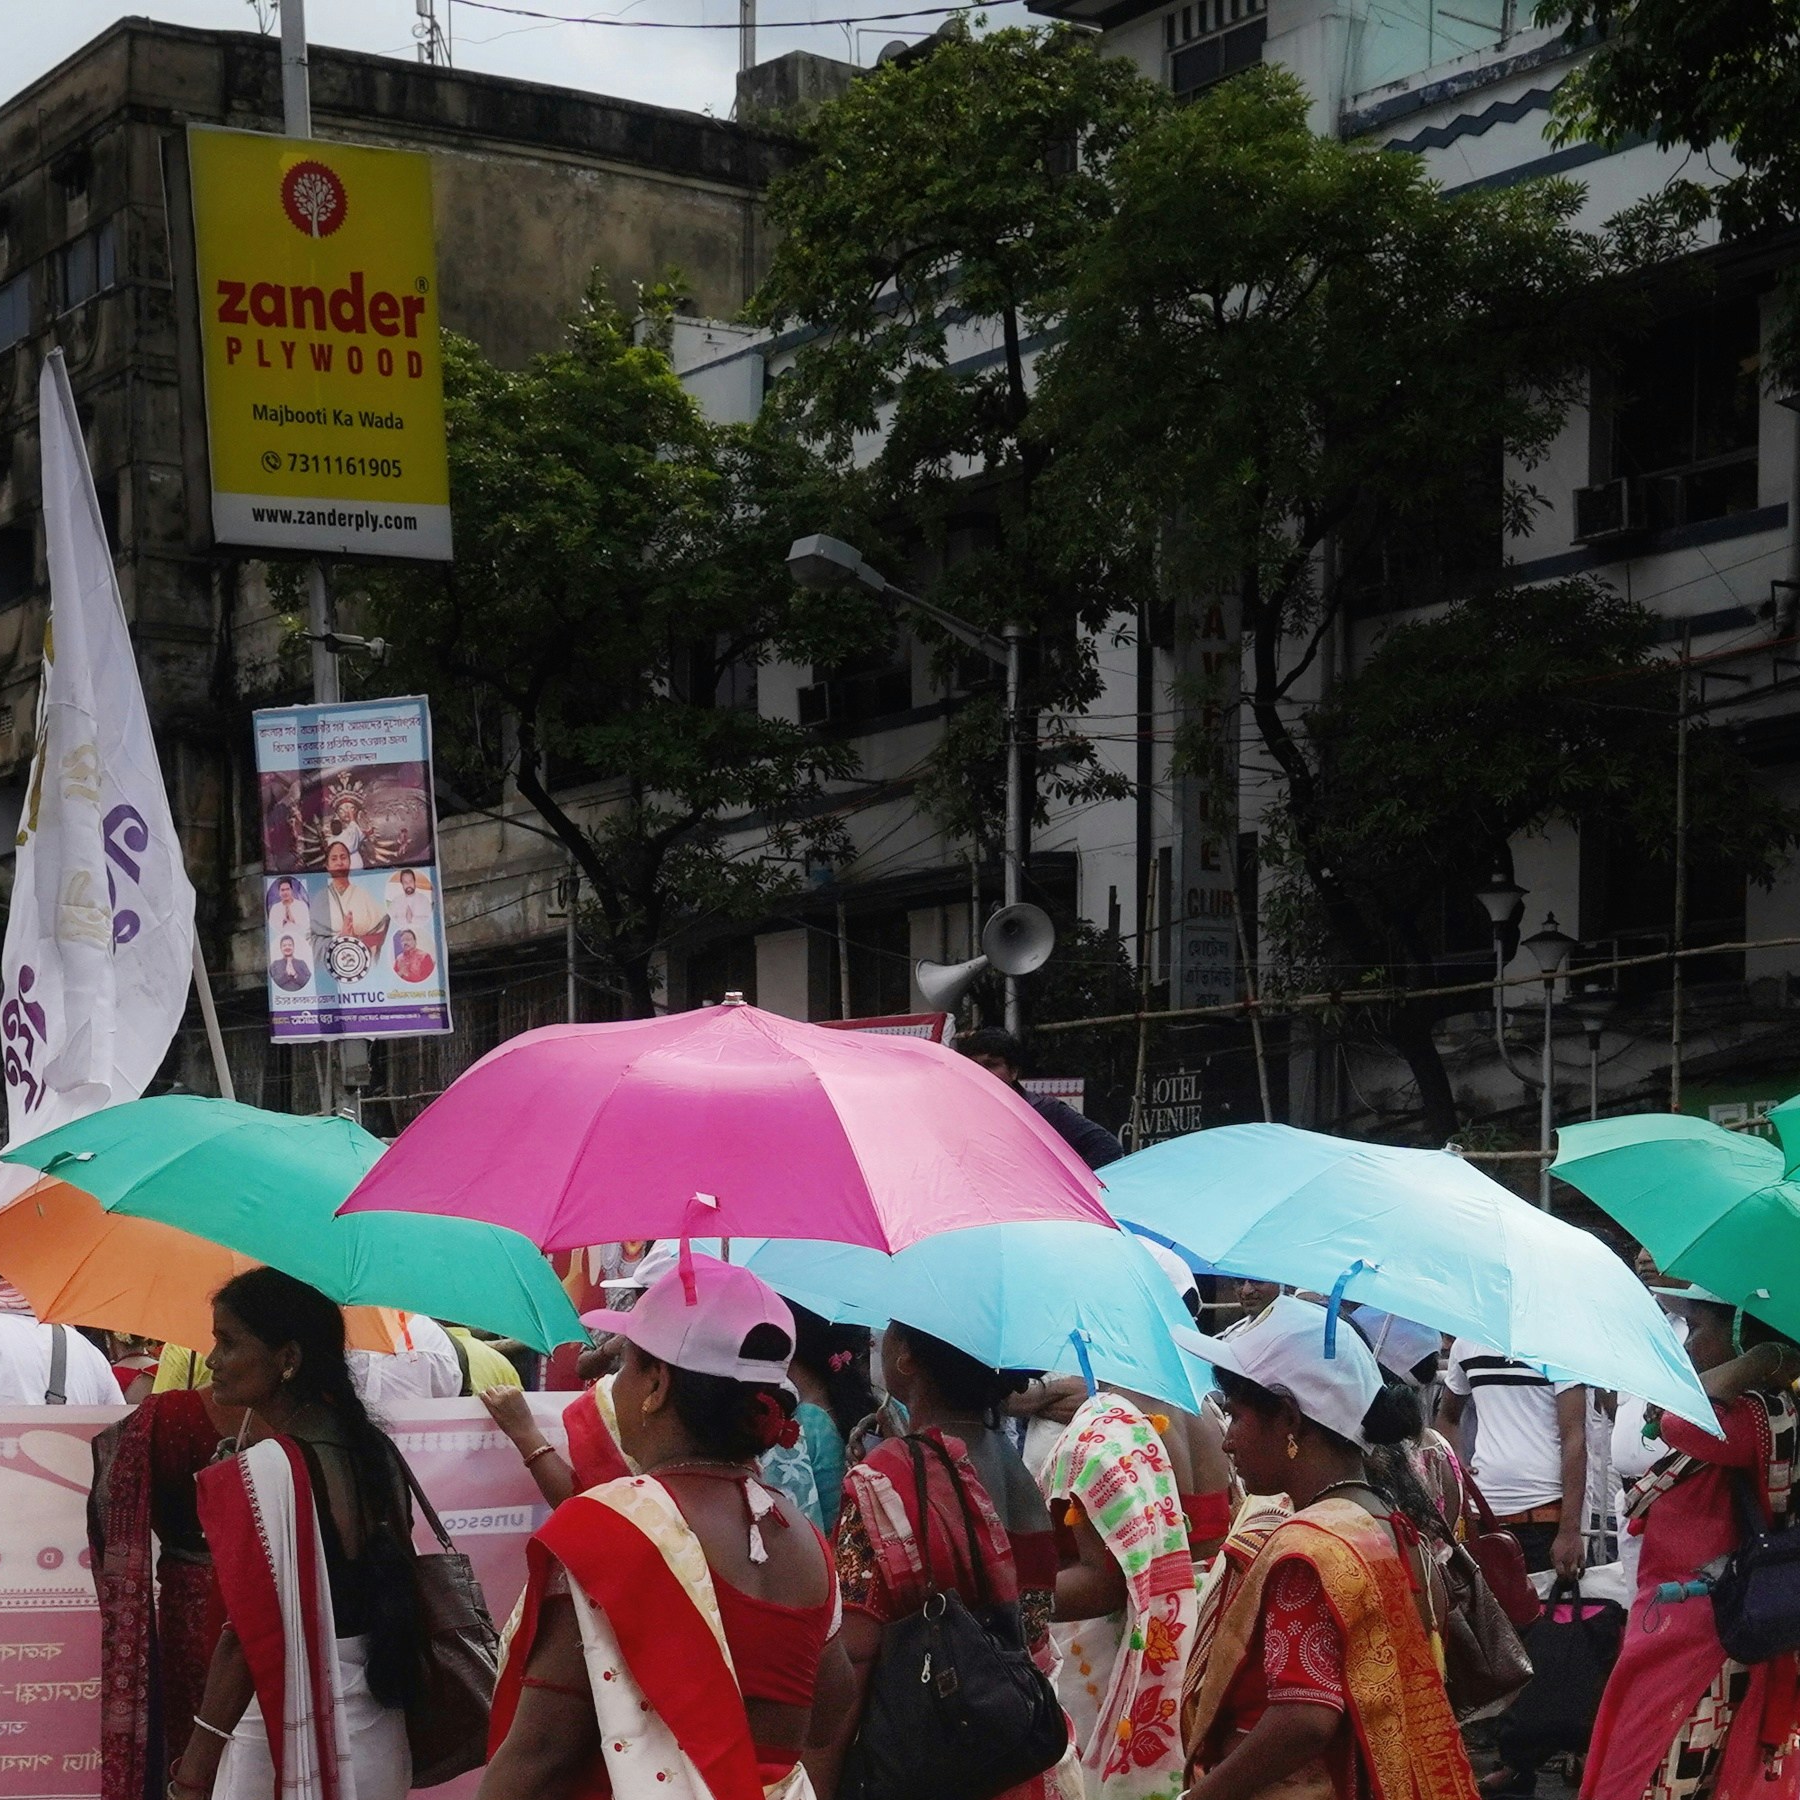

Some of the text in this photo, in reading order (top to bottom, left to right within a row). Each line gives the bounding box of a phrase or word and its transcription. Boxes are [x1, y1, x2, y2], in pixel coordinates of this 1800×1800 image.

[217, 272, 425, 338] zander
[227, 336, 424, 379] PLYWOOD
[252, 403, 404, 430] Majbooti Ka Wada
[288, 453, 402, 478] 7311161905
[252, 506, 417, 532] www.zanderply.com
[338, 991, 385, 1004] INTTUC
